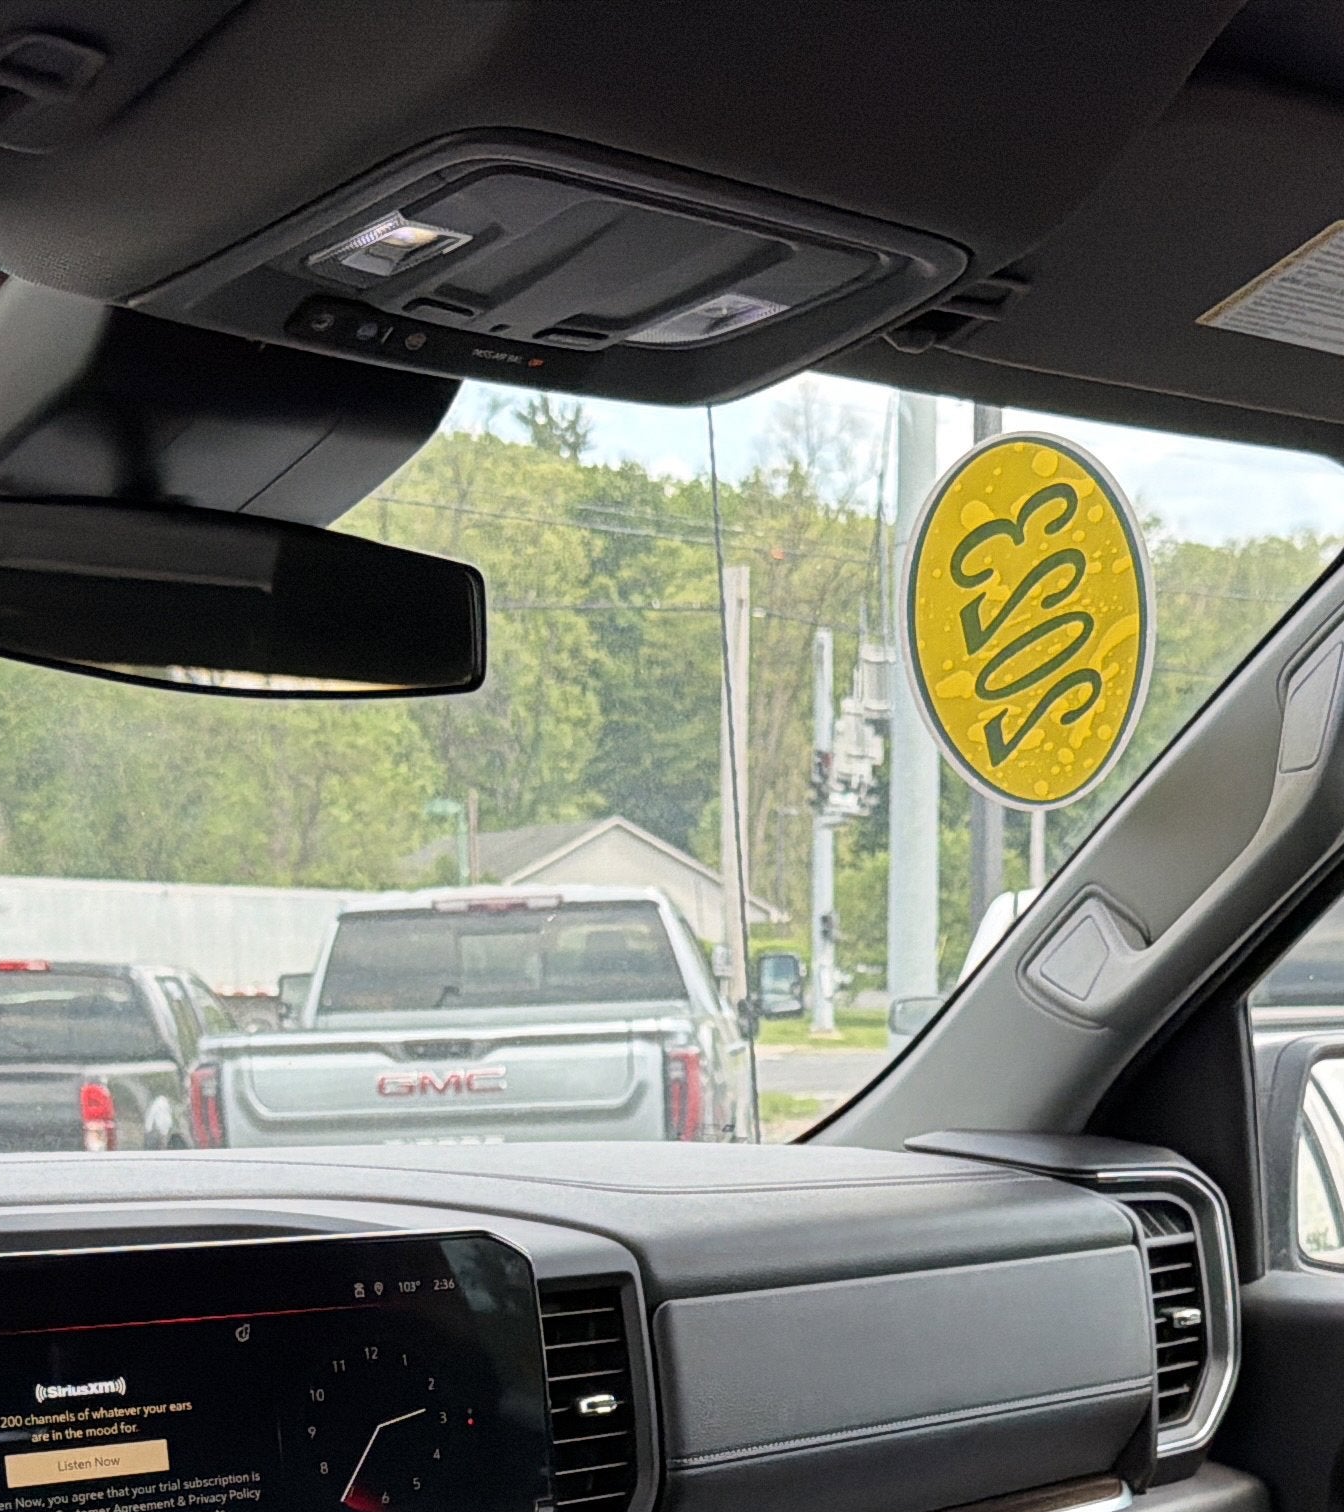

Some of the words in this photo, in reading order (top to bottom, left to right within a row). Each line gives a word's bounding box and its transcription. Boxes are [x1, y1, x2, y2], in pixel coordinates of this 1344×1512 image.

[376, 1065, 506, 1096] GMC
[433, 1279, 456, 1291] 2:36
[364, 1347, 378, 1360] 12
[401, 1354, 407, 1366] 1
[332, 1360, 346, 1373] 11
[428, 1378, 435, 1390] 2
[309, 1388, 325, 1402] 10
[0, 1416, 23, 1429] 200
[25, 1409, 76, 1427] channels
[77, 1408, 90, 1421] of
[91, 1405, 141, 1421] whatever
[142, 1402, 167, 1420] your
[169, 1401, 192, 1412] ears
[439, 1411, 447, 1424] 3
[31, 1431, 50, 1443] are
[52, 1429, 63, 1441] in
[65, 1426, 83, 1439] the
[85, 1423, 118, 1438] mood
[120, 1421, 140, 1434] for.
[308, 1426, 317, 1439] 9
[433, 1448, 441, 1460] 4
[57, 1457, 92, 1472] Listen
[94, 1455, 120, 1468] Now
[320, 1462, 329, 1475] 8
[15, 1497, 45, 1510] Now,
[47, 1494, 69, 1509] you
[71, 1490, 104, 1505] agree
[106, 1486, 130, 1499] that
[131, 1484, 157, 1499] your
[159, 1478, 181, 1492] trial
[182, 1473, 250, 1490] subscription
[251, 1471, 261, 1482] is
[413, 1478, 421, 1490] 5
[177, 1496, 187, 1507] &
[188, 1492, 227, 1507] Privacy
[229, 1487, 261, 1501] Policy
[381, 1492, 390, 1504] 6
